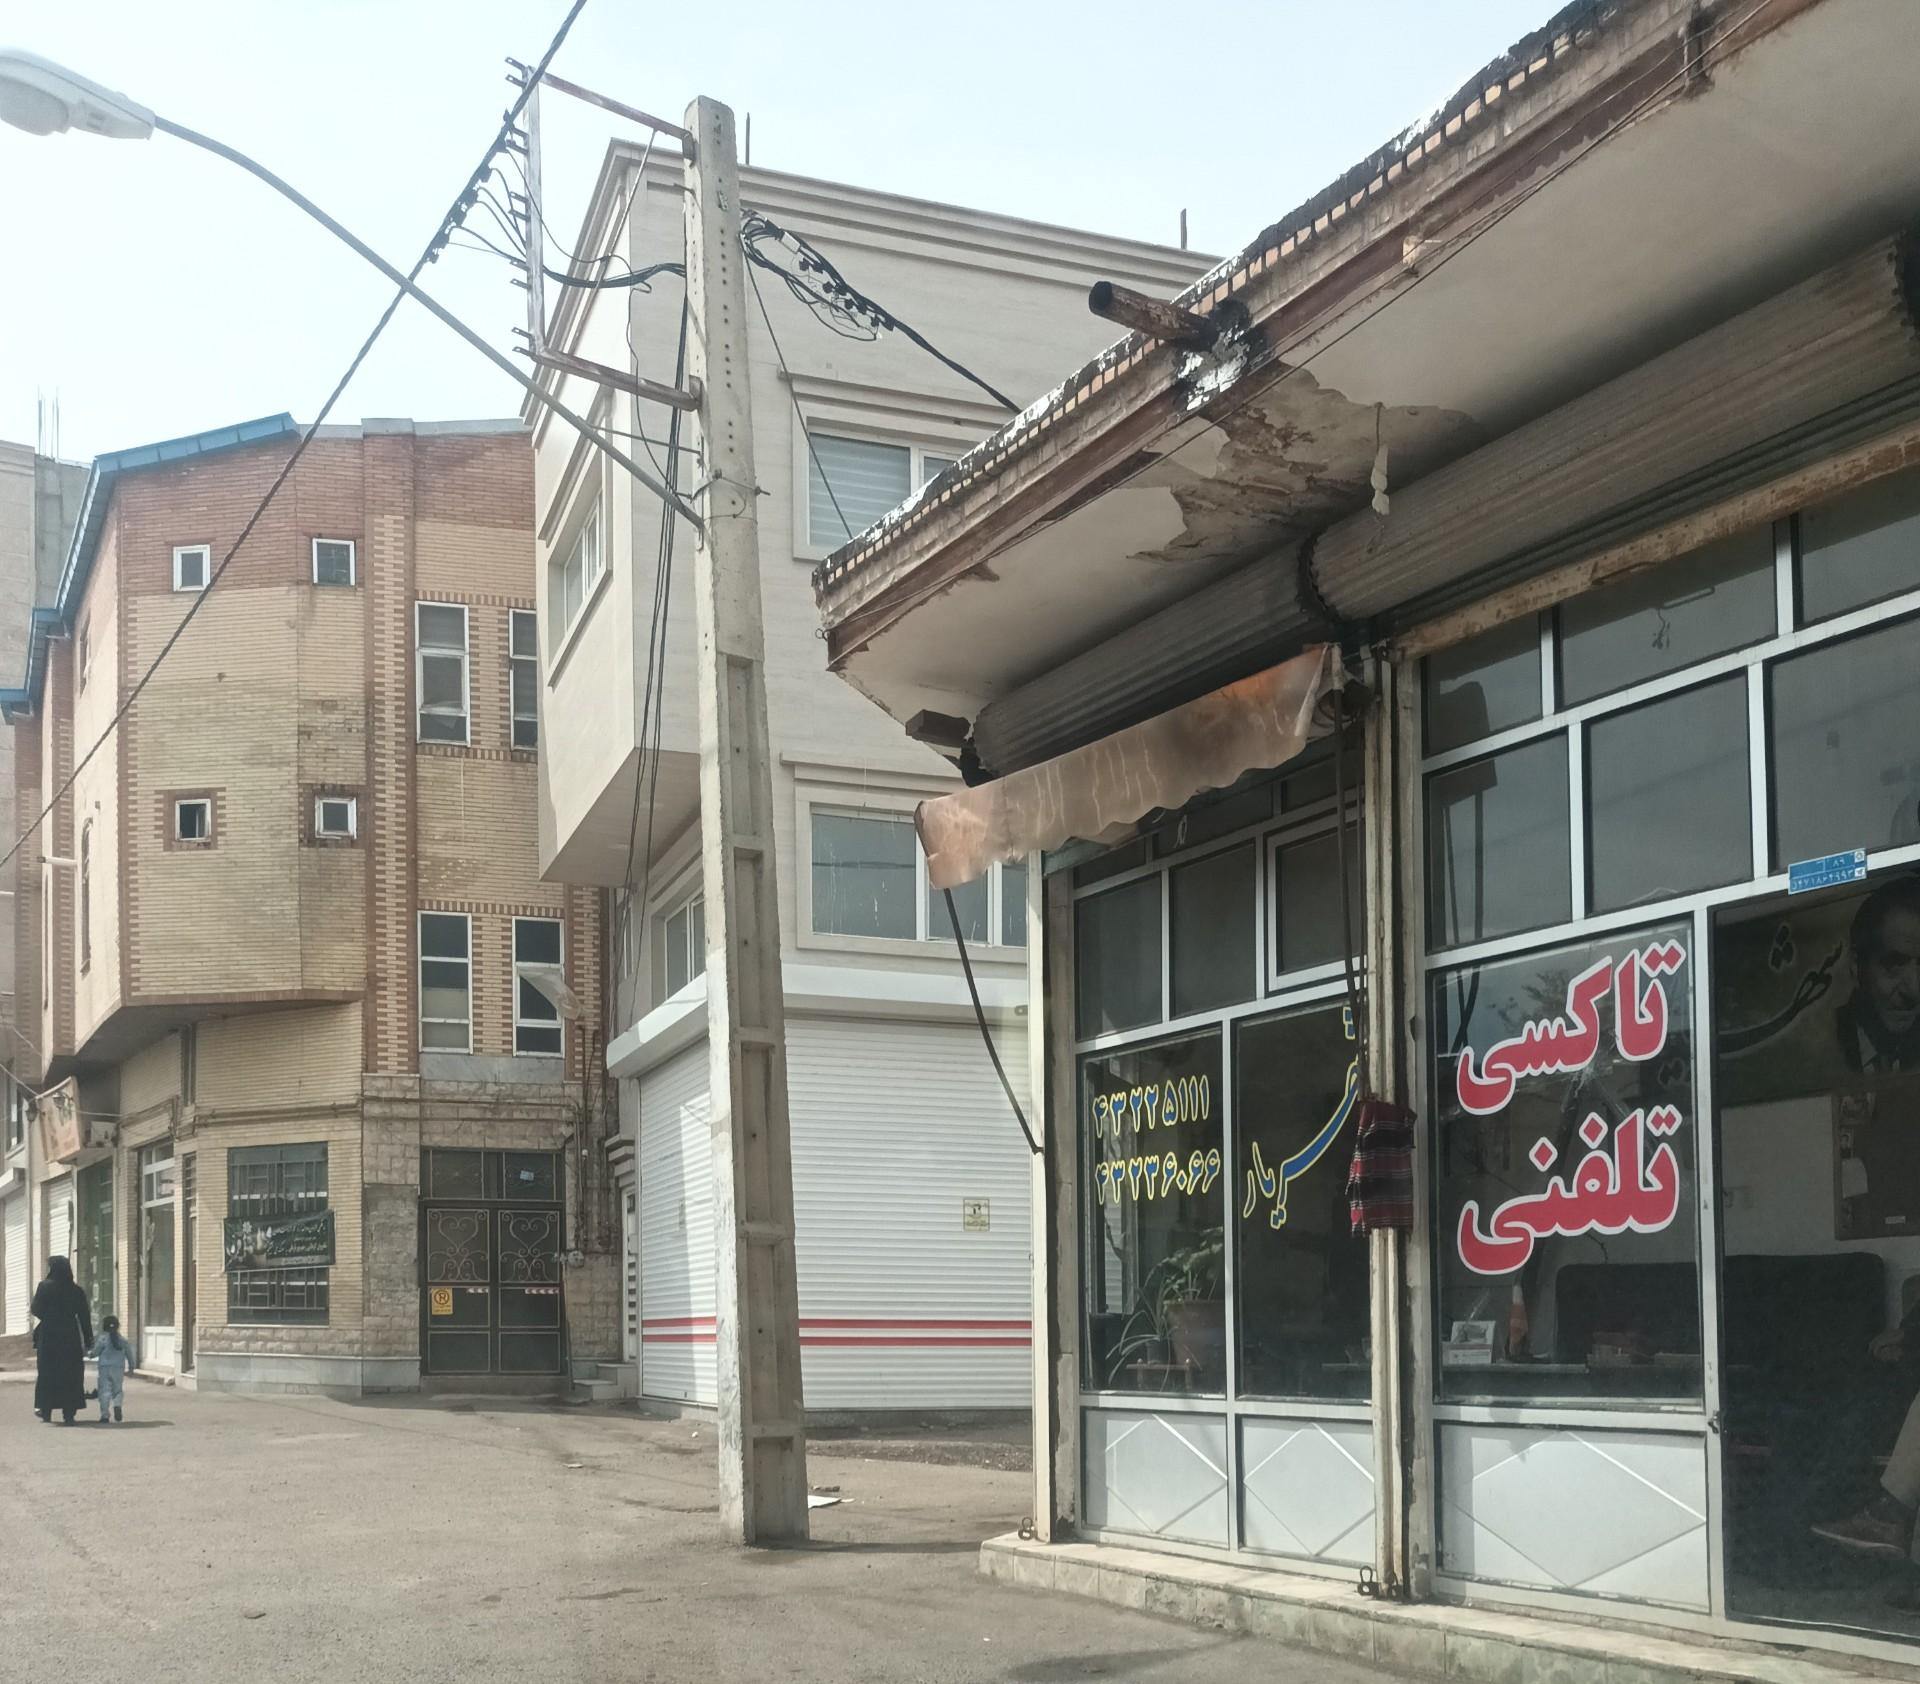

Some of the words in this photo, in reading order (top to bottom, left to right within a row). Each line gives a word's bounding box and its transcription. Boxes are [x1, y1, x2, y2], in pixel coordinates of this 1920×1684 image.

[1456, 939, 1687, 1115] تاکسی
[1092, 1074, 1210, 1139] ۴۳۲۲۵۱۱۱
[1094, 1148, 1221, 1206] ۴۳۲۳۶۰۶۶
[1457, 1103, 1683, 1275] تلفنی
